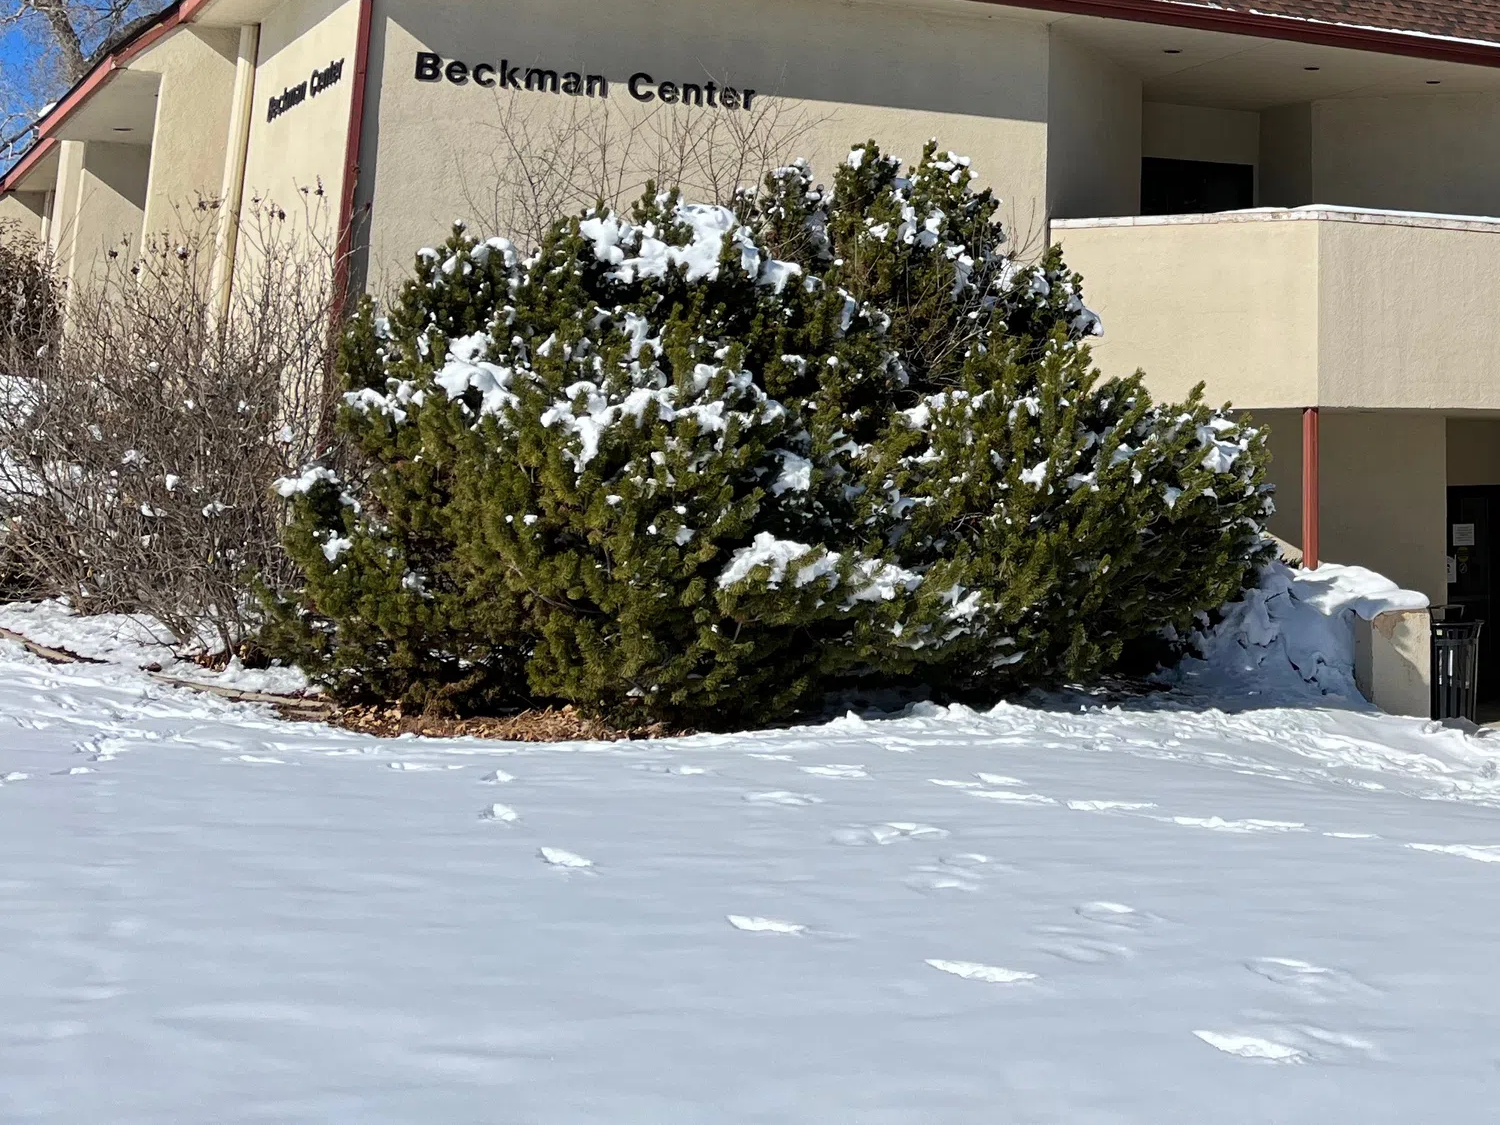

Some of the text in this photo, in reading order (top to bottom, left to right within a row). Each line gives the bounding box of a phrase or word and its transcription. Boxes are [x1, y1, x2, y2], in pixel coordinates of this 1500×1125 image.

[266, 58, 344, 123] Beckman Center
[415, 52, 755, 110] Beckman Center
